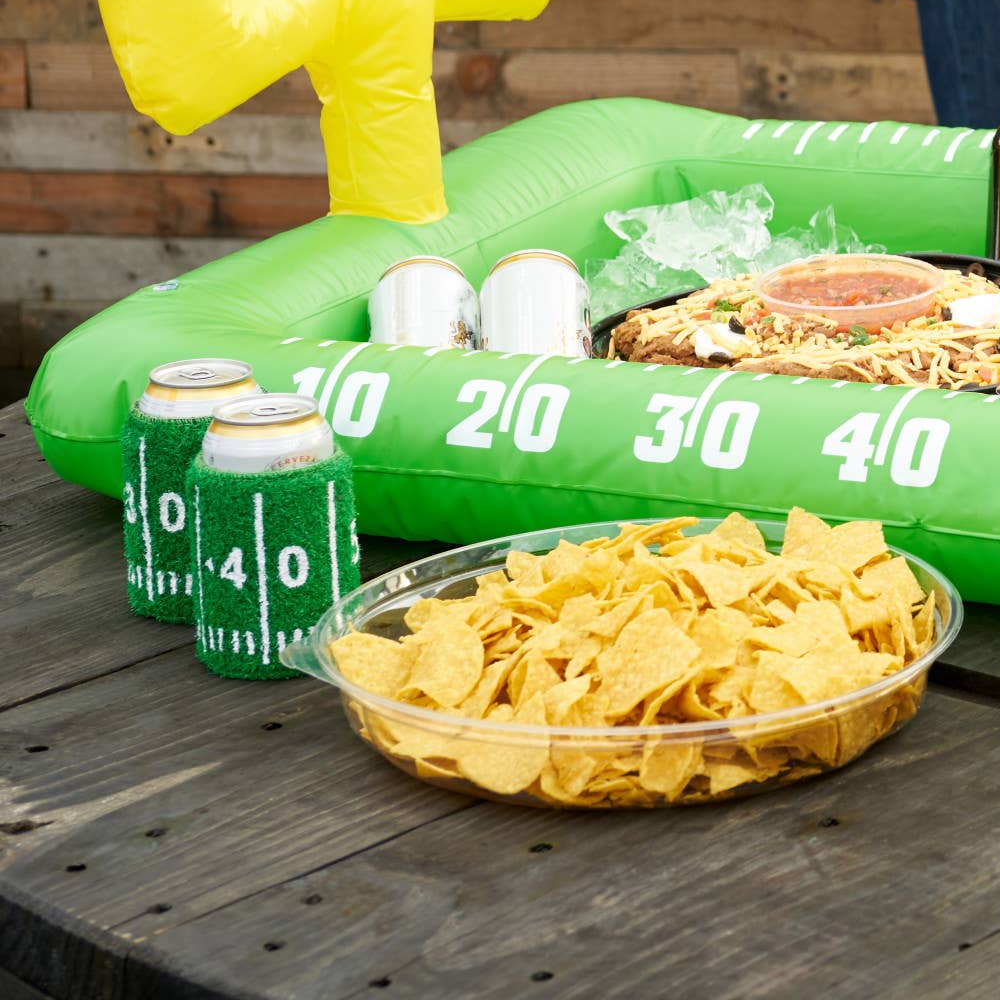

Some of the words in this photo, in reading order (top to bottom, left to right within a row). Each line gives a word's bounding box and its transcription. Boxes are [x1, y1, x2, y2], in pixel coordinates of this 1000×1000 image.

[446, 379, 571, 453] 20
[633, 393, 761, 470] 30
[821, 412, 951, 488] 40
